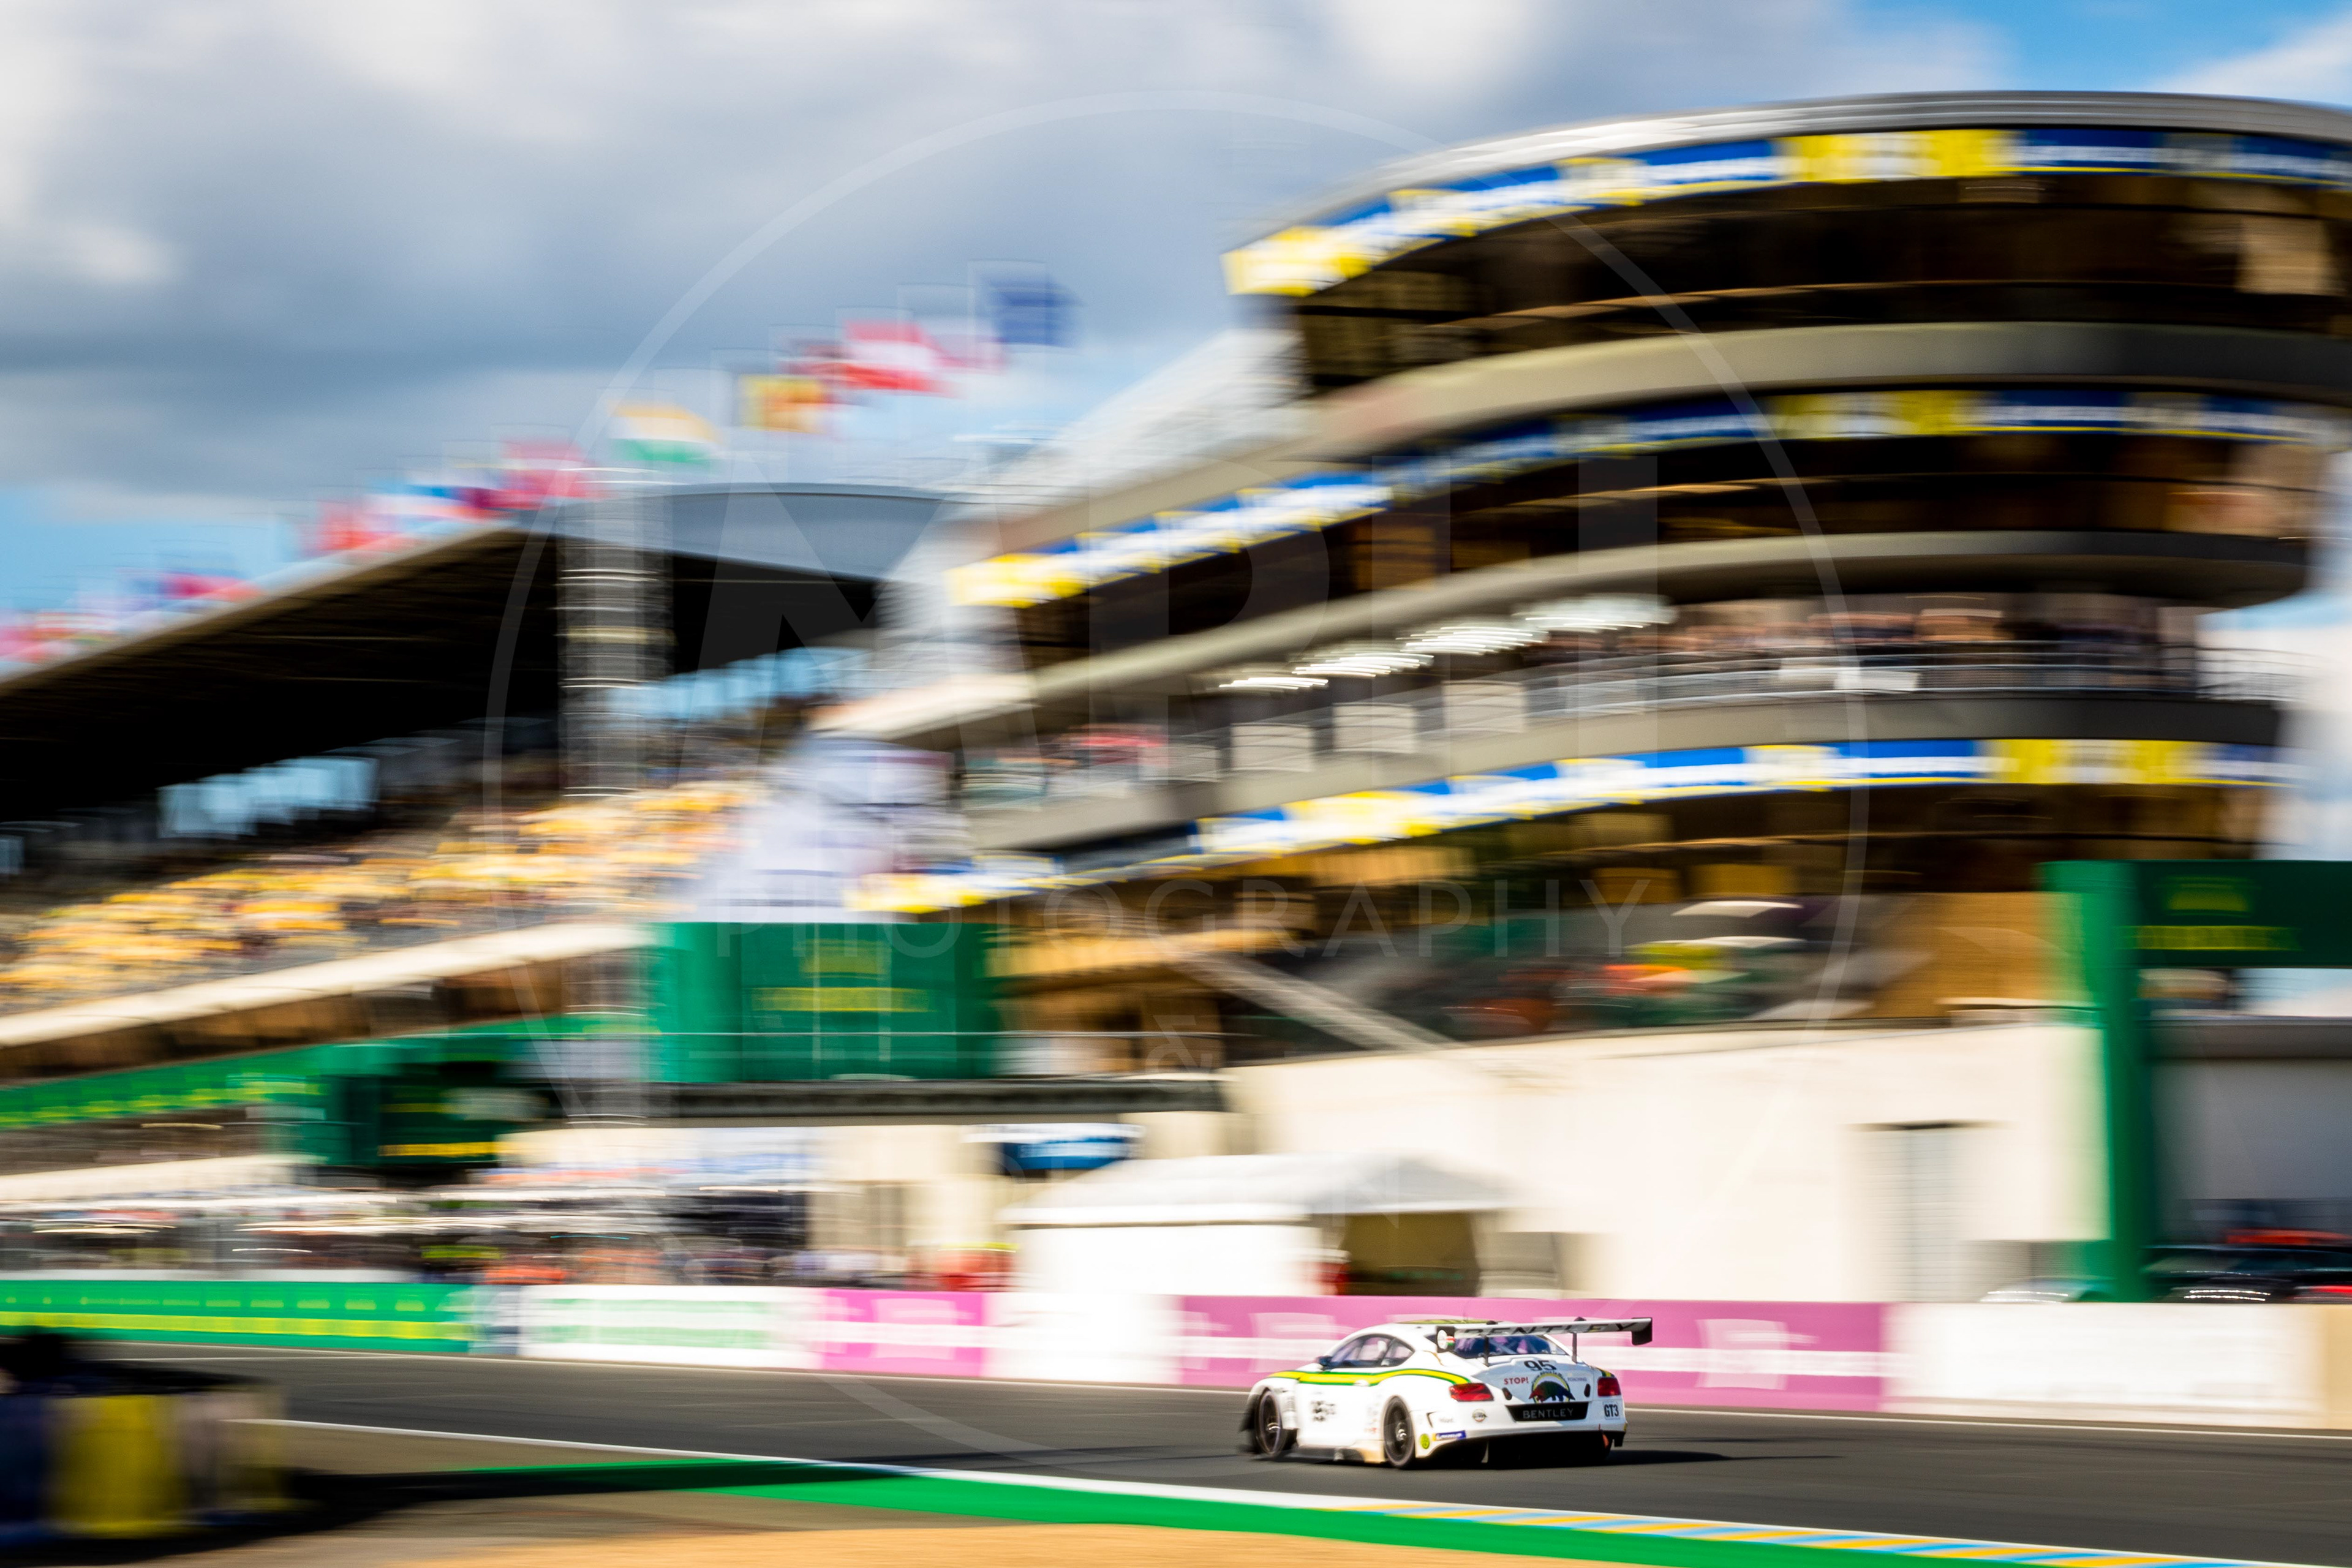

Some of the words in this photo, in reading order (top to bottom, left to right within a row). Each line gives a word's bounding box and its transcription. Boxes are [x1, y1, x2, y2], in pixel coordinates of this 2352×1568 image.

[1523, 1359, 1557, 1371] 95
[1504, 1376, 1529, 1385] STOP!
[1523, 1408, 1574, 1419] BENTLEY
[1604, 1403, 1619, 1418] GT3
